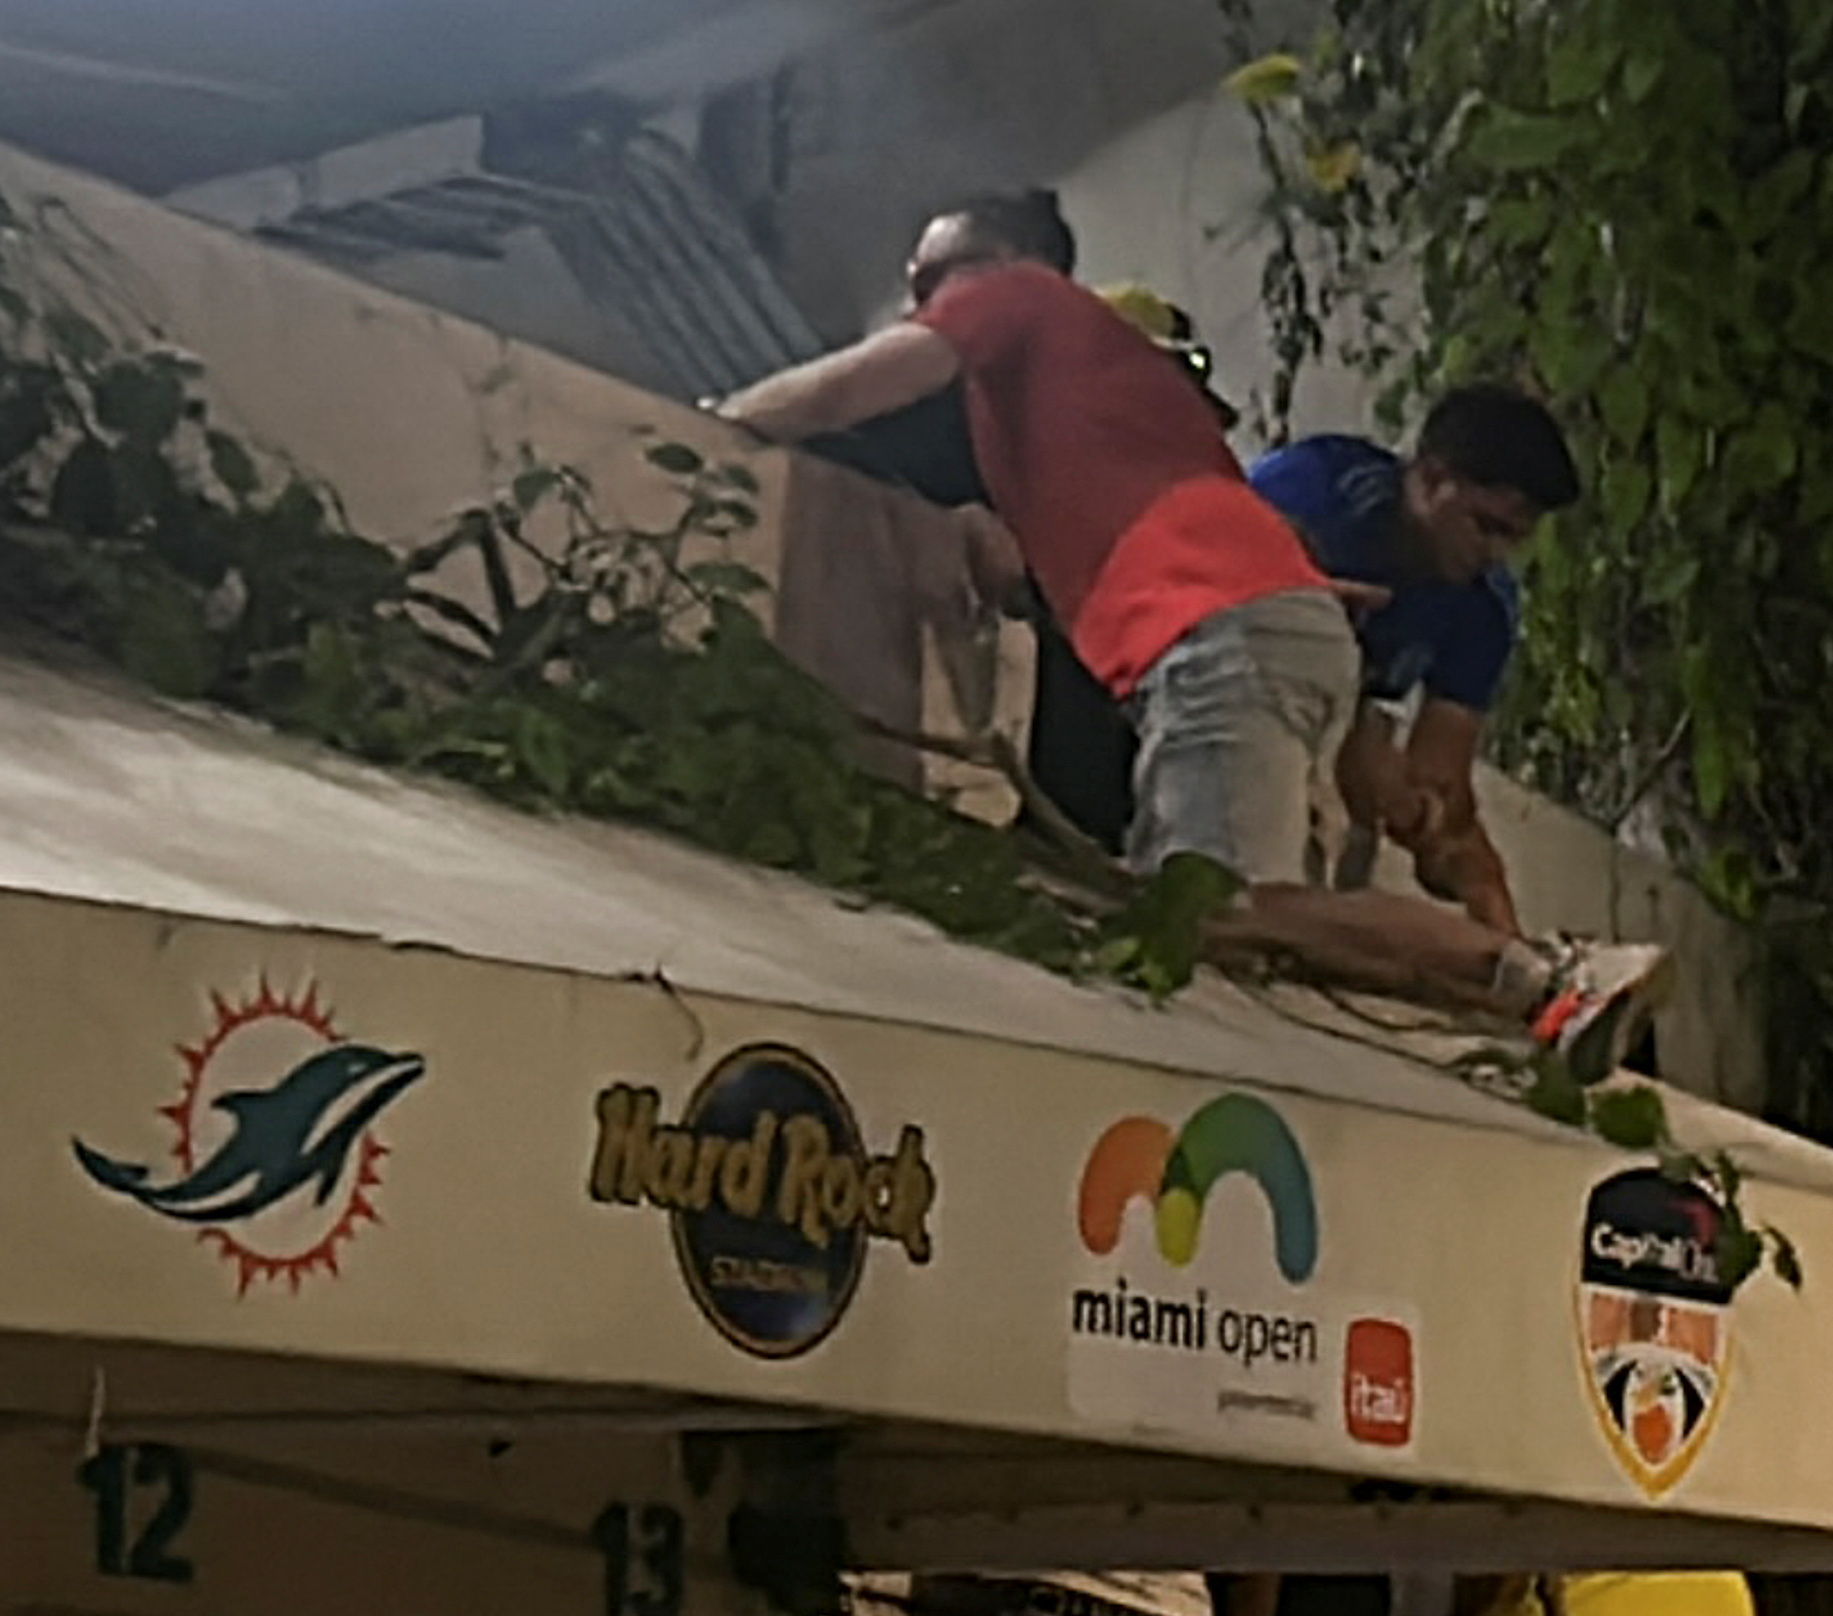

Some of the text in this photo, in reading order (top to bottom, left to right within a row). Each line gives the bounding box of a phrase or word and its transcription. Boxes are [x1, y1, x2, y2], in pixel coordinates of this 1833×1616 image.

[589, 1083, 937, 1265] Hard Rock
[1072, 1275, 1317, 1368] miami open
[78, 1442, 194, 1584] 12
